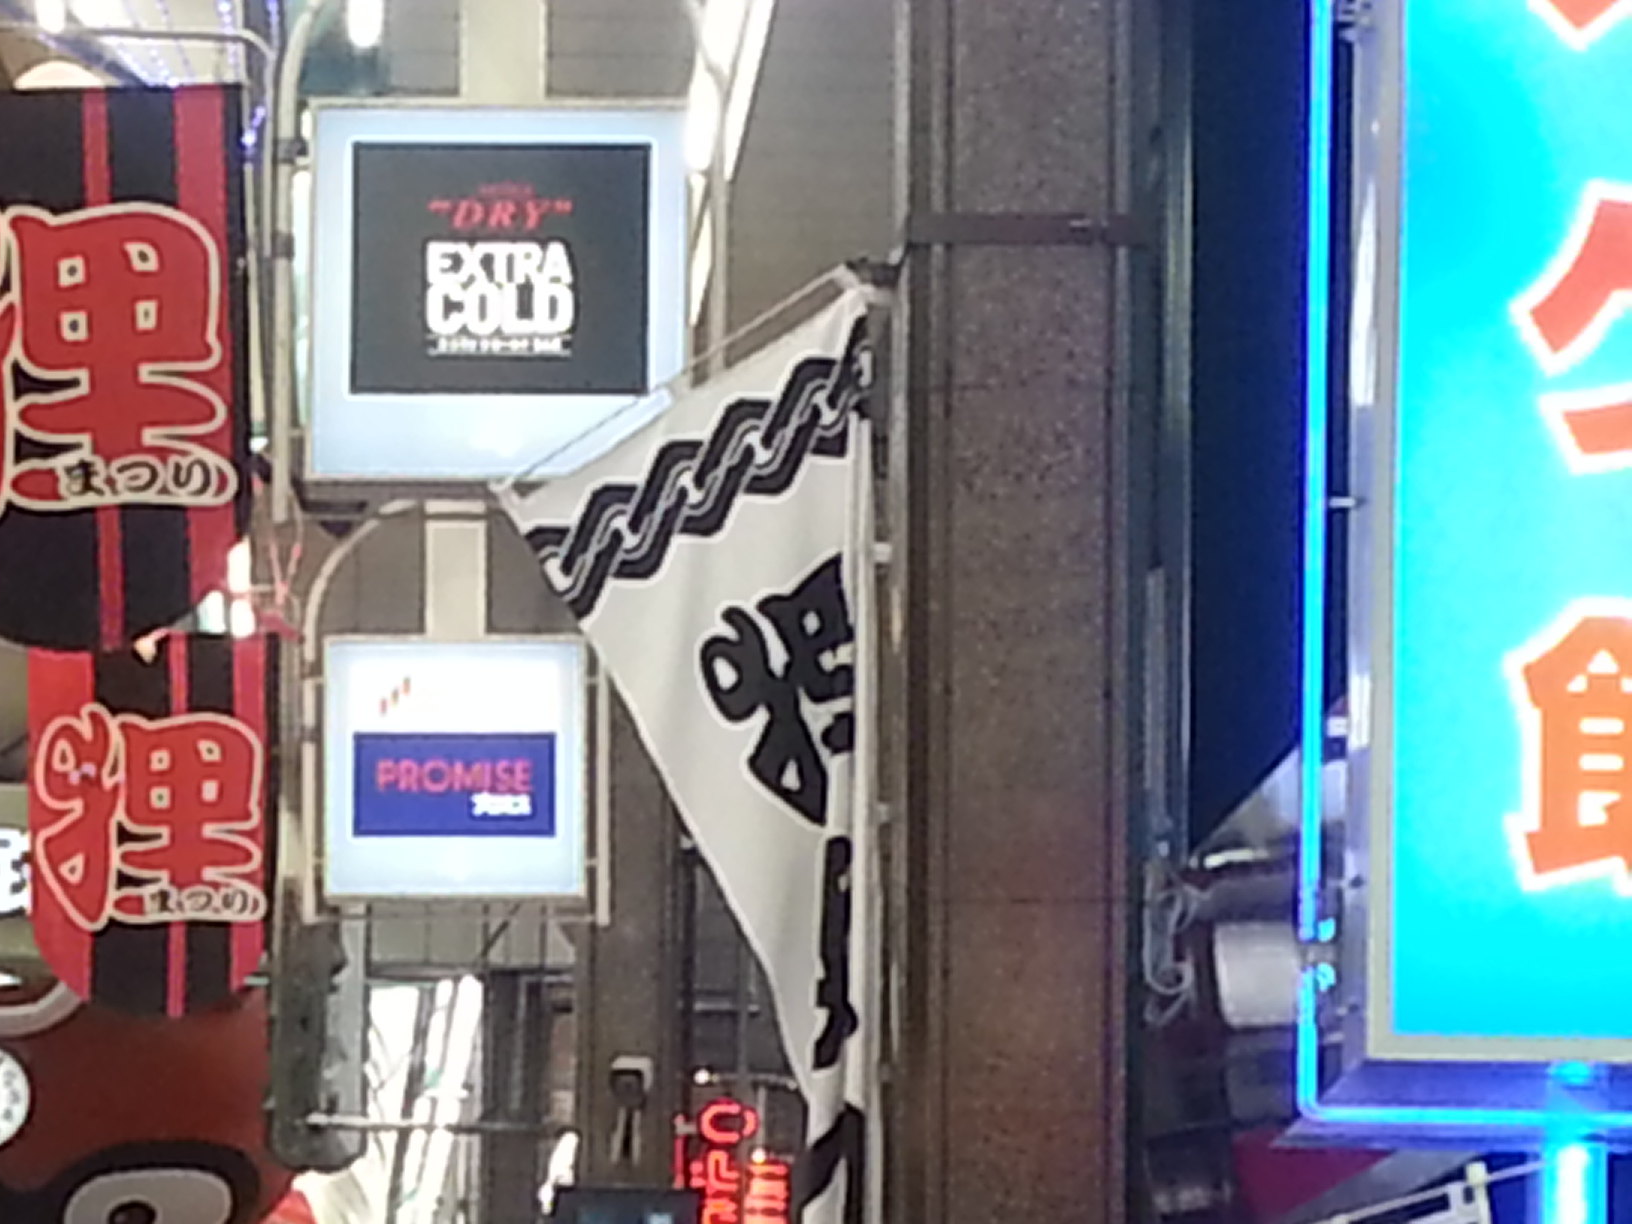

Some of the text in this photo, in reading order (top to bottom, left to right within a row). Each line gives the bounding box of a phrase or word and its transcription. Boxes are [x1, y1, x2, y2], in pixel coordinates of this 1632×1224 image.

[426, 241, 572, 283] EXTRA
[426, 284, 574, 334] COLD
[69, 462, 213, 498] まつり
[376, 758, 532, 792] PROMISE
[35, 704, 265, 927] 狸
